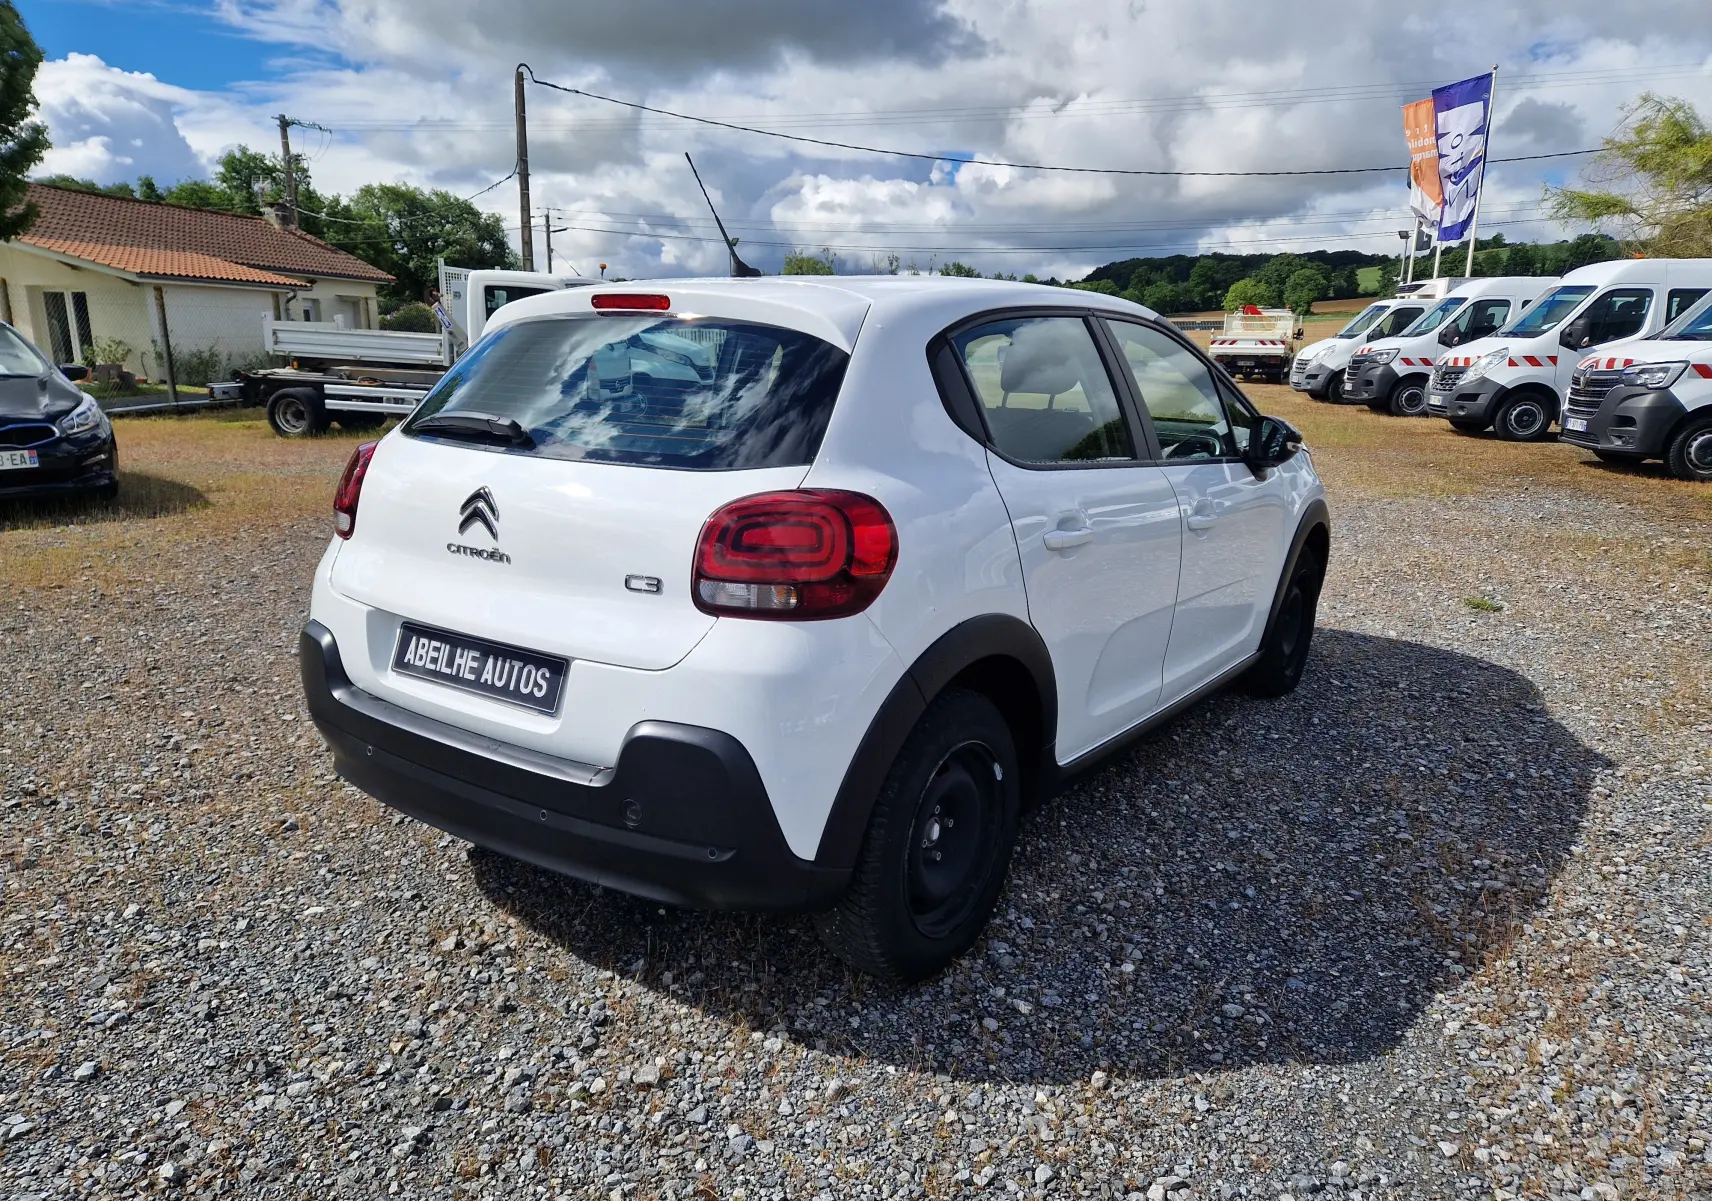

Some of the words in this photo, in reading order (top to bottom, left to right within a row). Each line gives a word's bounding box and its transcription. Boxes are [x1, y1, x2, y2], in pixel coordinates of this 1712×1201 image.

[446, 542, 511, 565] CITROËN
[624, 574, 662, 594] C3
[403, 635, 480, 680] ABEILHE
[480, 655, 550, 698] AUTOS
